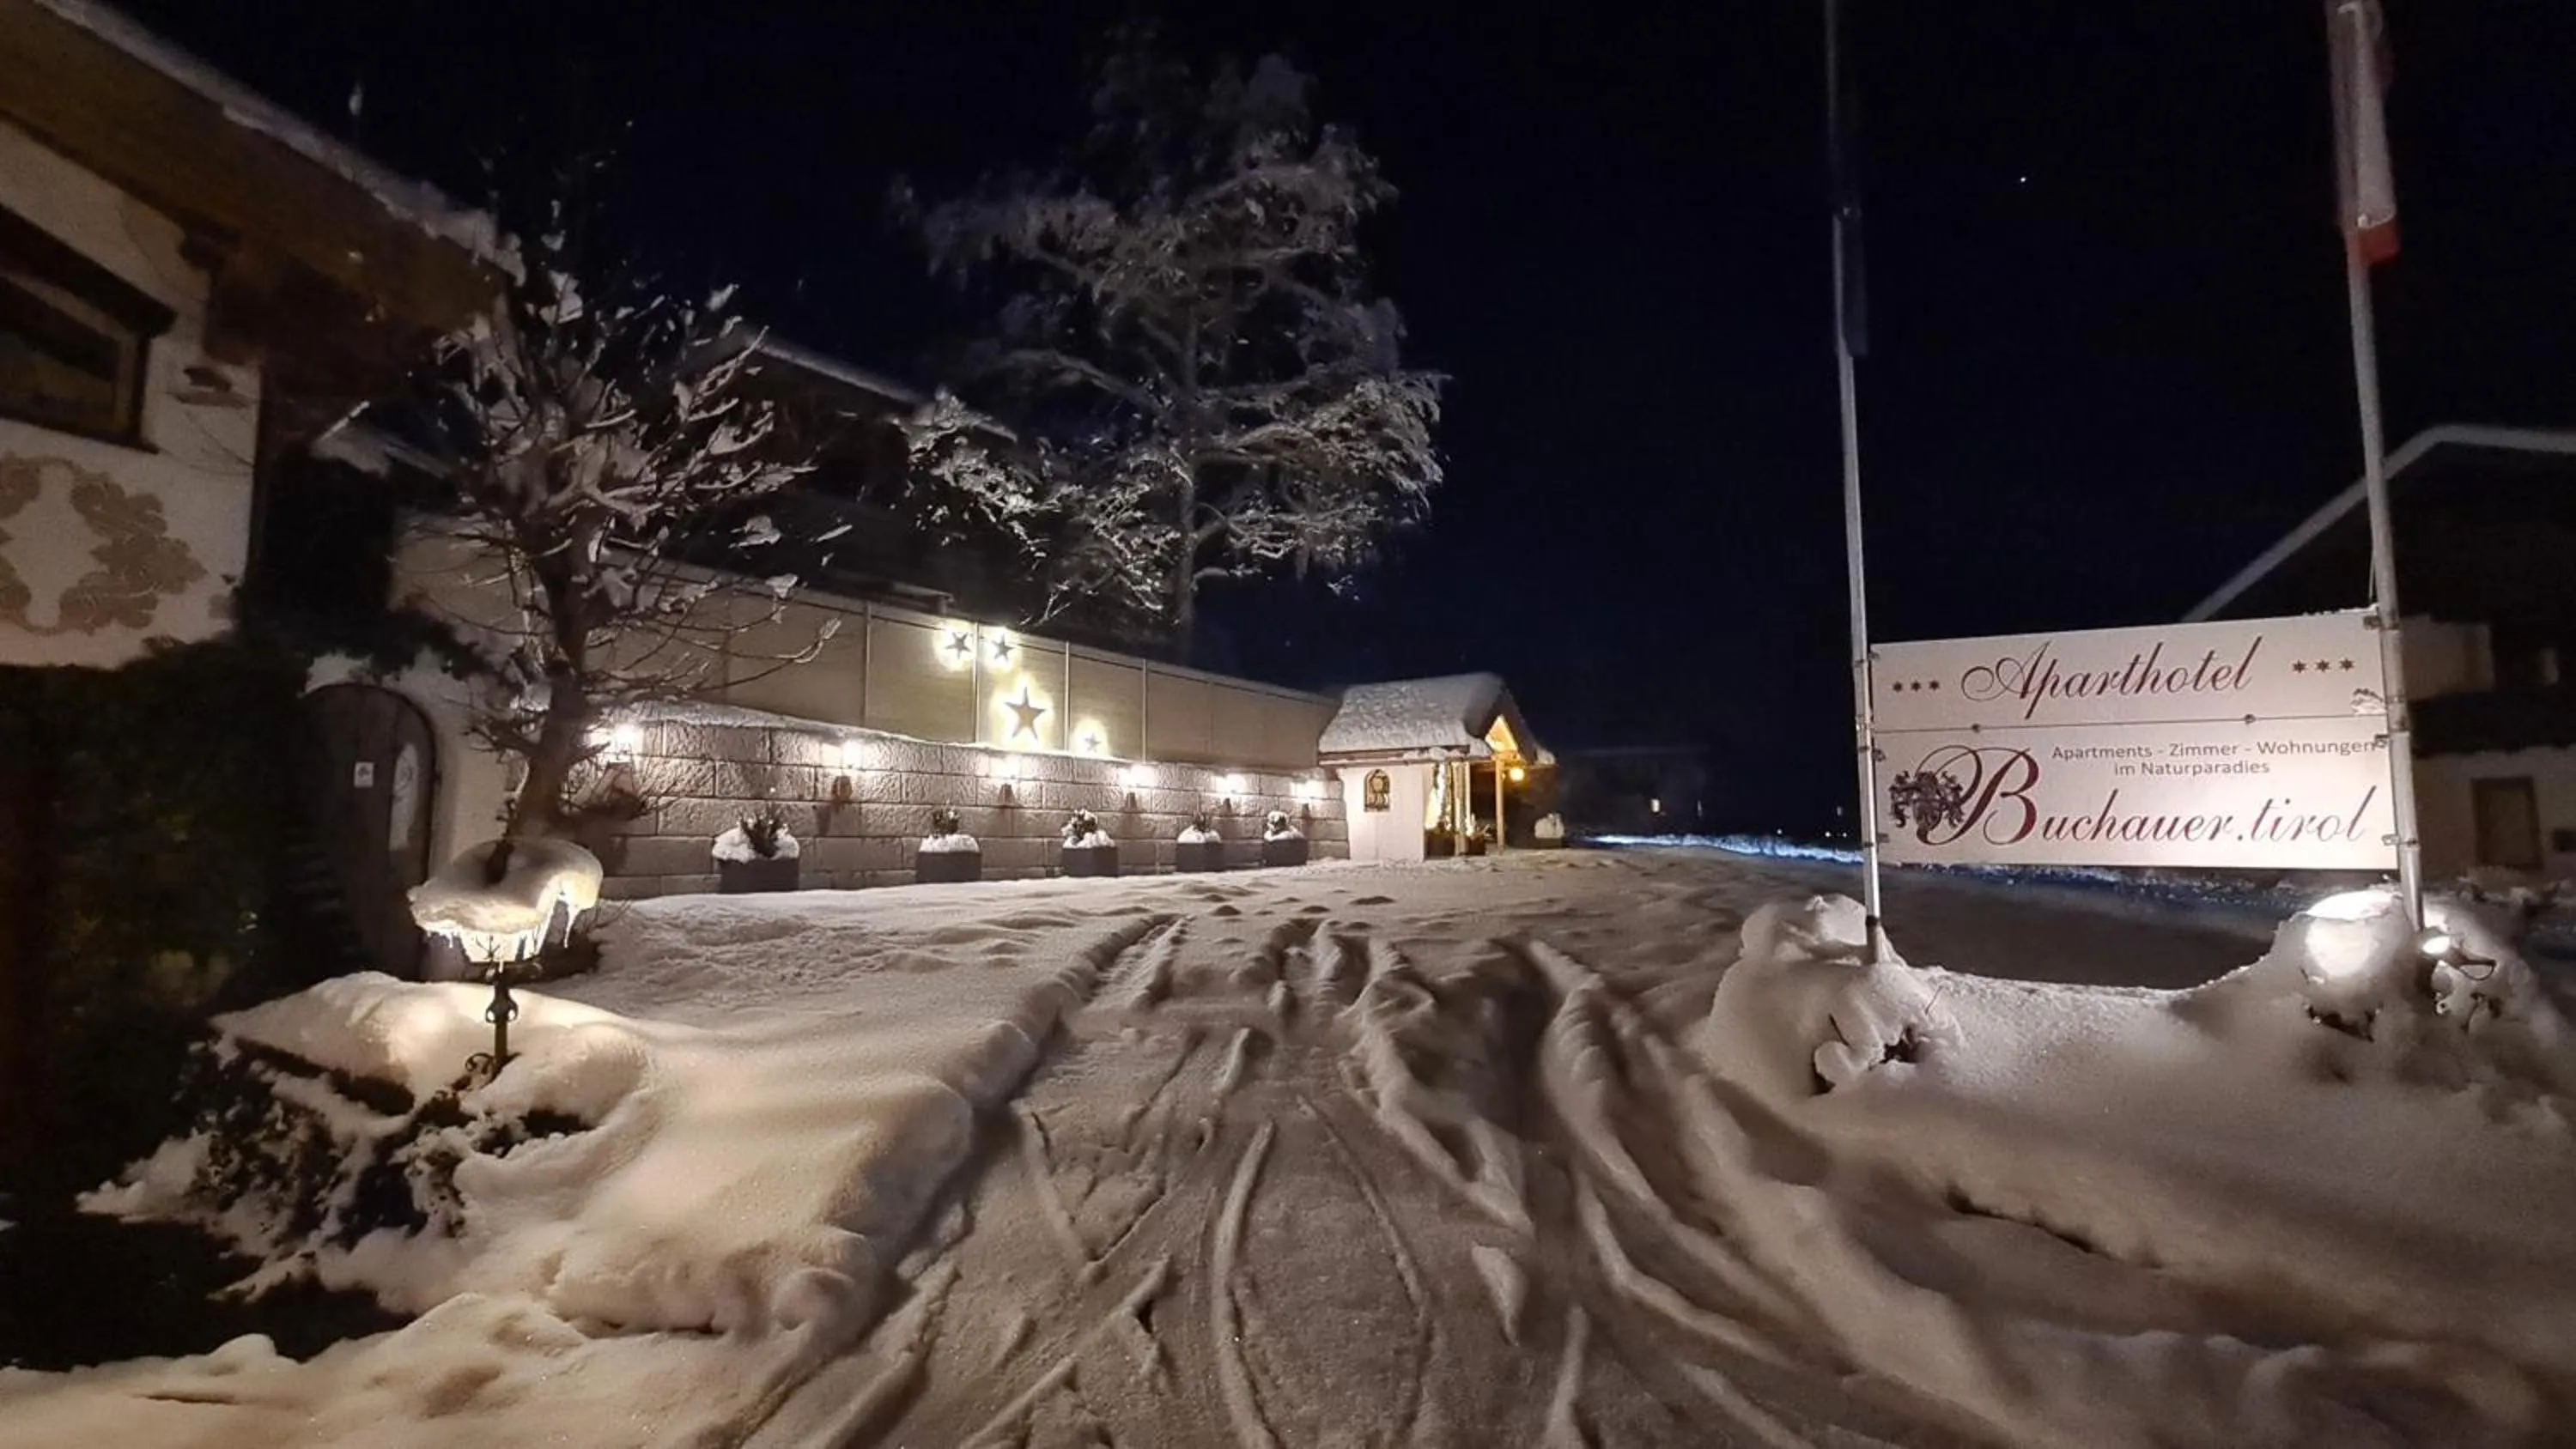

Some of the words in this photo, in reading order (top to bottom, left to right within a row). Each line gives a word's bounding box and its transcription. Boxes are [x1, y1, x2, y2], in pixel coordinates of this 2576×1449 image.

[1960, 636, 2263, 720] Aparthotel
[2051, 744, 2153, 761] Apartments
[2169, 742, 2239, 757] Zimmer
[2257, 738, 2376, 756] Wohnungen
[2114, 762, 2136, 776] im
[2141, 761, 2271, 777] Naturparadies
[1915, 744, 2377, 846] Buchauer.tirol
